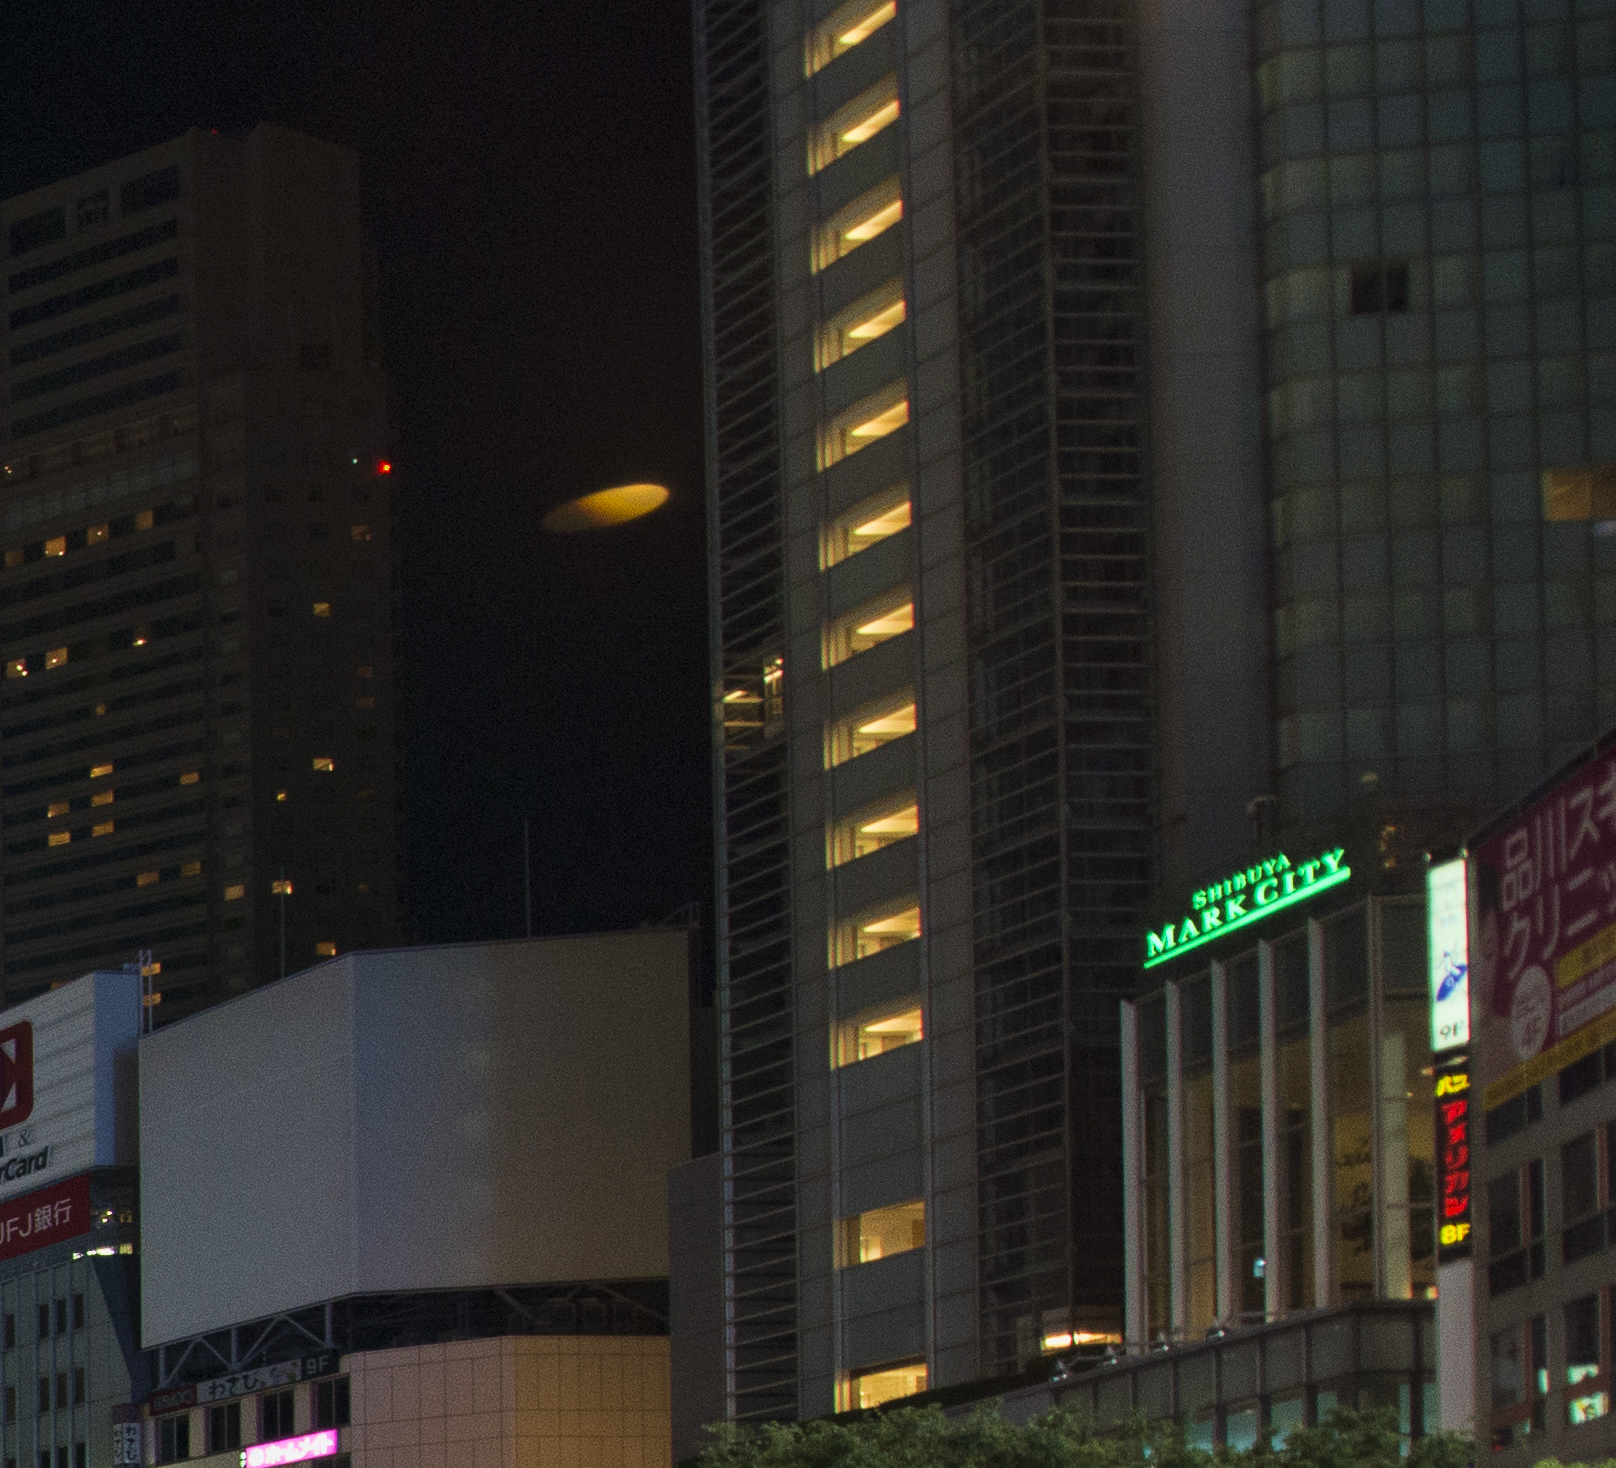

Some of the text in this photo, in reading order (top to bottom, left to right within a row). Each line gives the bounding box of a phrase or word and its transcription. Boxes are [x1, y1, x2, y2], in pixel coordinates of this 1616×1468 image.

[1192, 852, 1291, 910] SHIBUYA
[1146, 849, 1345, 957] MARK CITY
[17, 1128, 33, 1149] &
[1440, 1223, 1471, 1245] 8F
